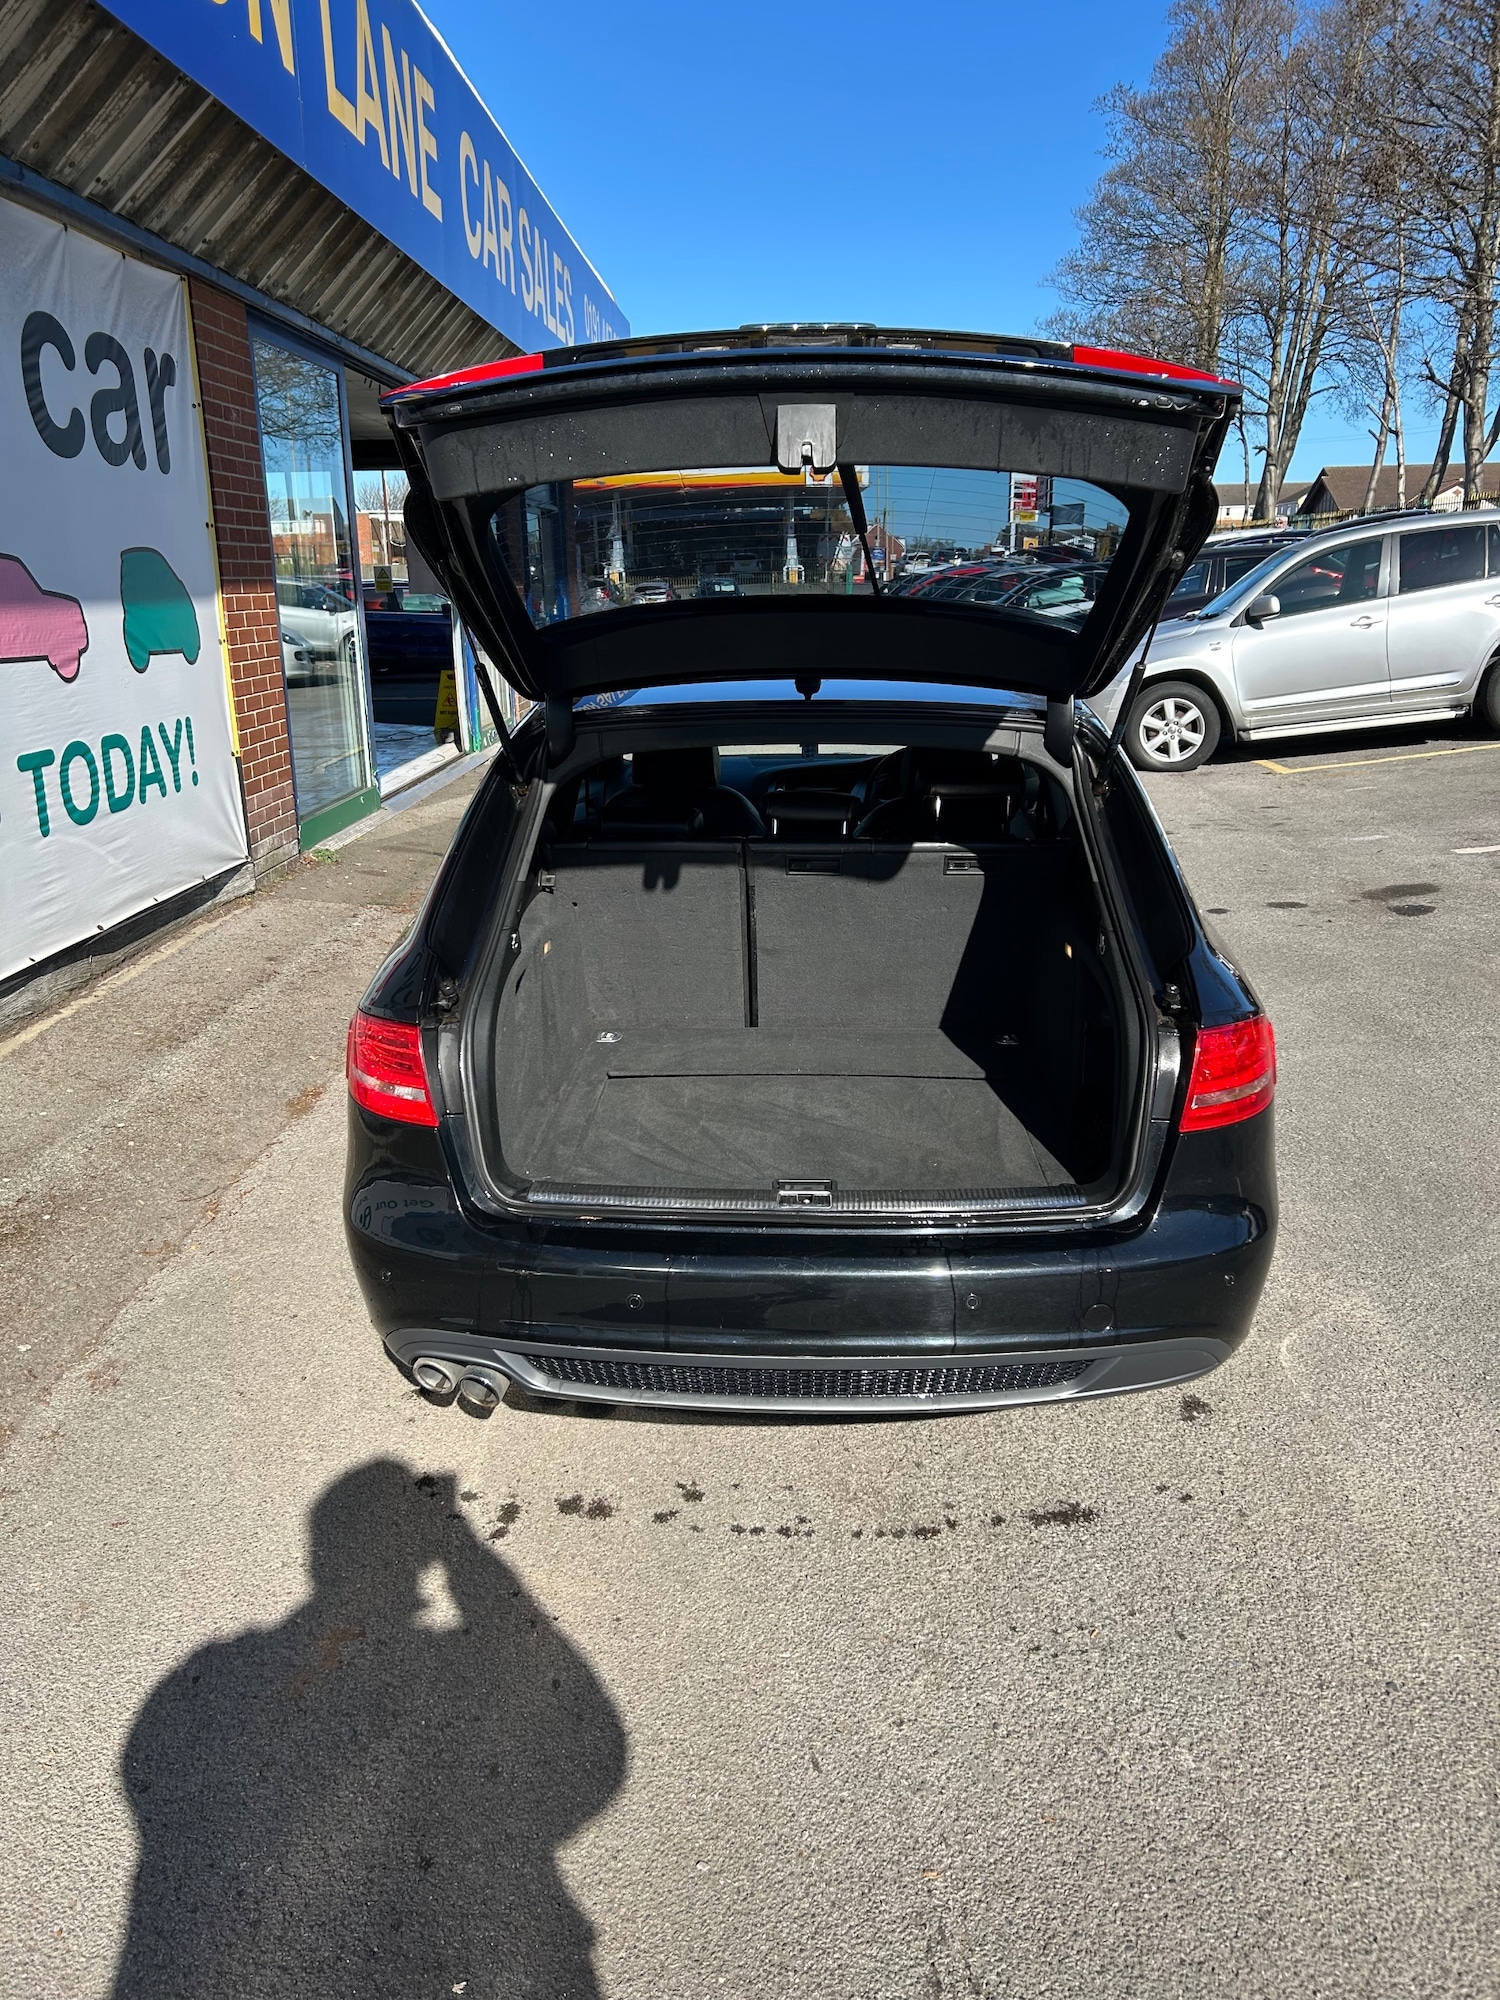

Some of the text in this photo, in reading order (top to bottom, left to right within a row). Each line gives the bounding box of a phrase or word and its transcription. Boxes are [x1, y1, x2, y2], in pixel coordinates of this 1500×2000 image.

[320, 0, 443, 223] LANE
[459, 130, 516, 296] CAR
[518, 207, 575, 346] SALES
[21, 310, 176, 475] car
[17, 716, 199, 838] TODAY!
